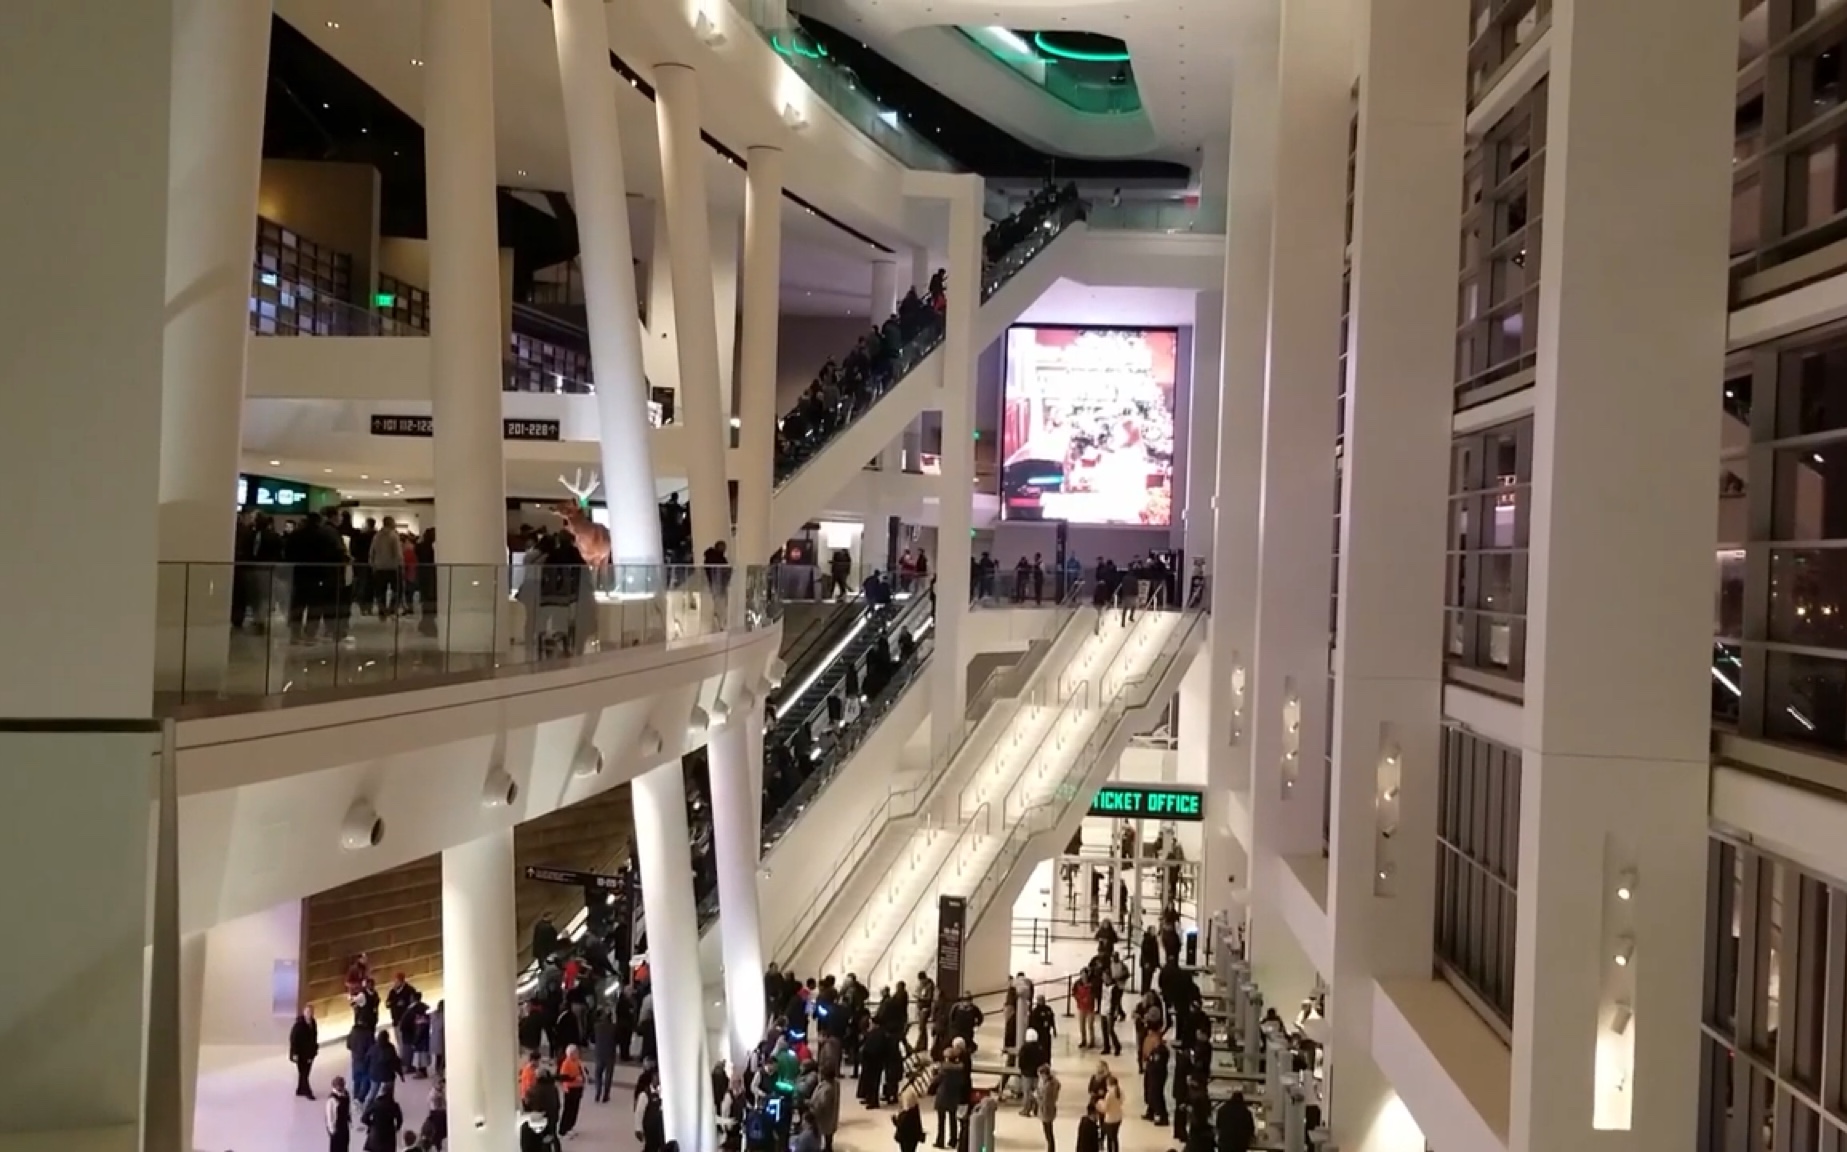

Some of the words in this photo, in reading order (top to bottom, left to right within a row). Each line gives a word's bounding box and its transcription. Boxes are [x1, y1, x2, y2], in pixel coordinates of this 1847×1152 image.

[383, 419, 397, 430] 101
[508, 423, 548, 436] 201-228
[1147, 793, 1199, 813] OFFICE
